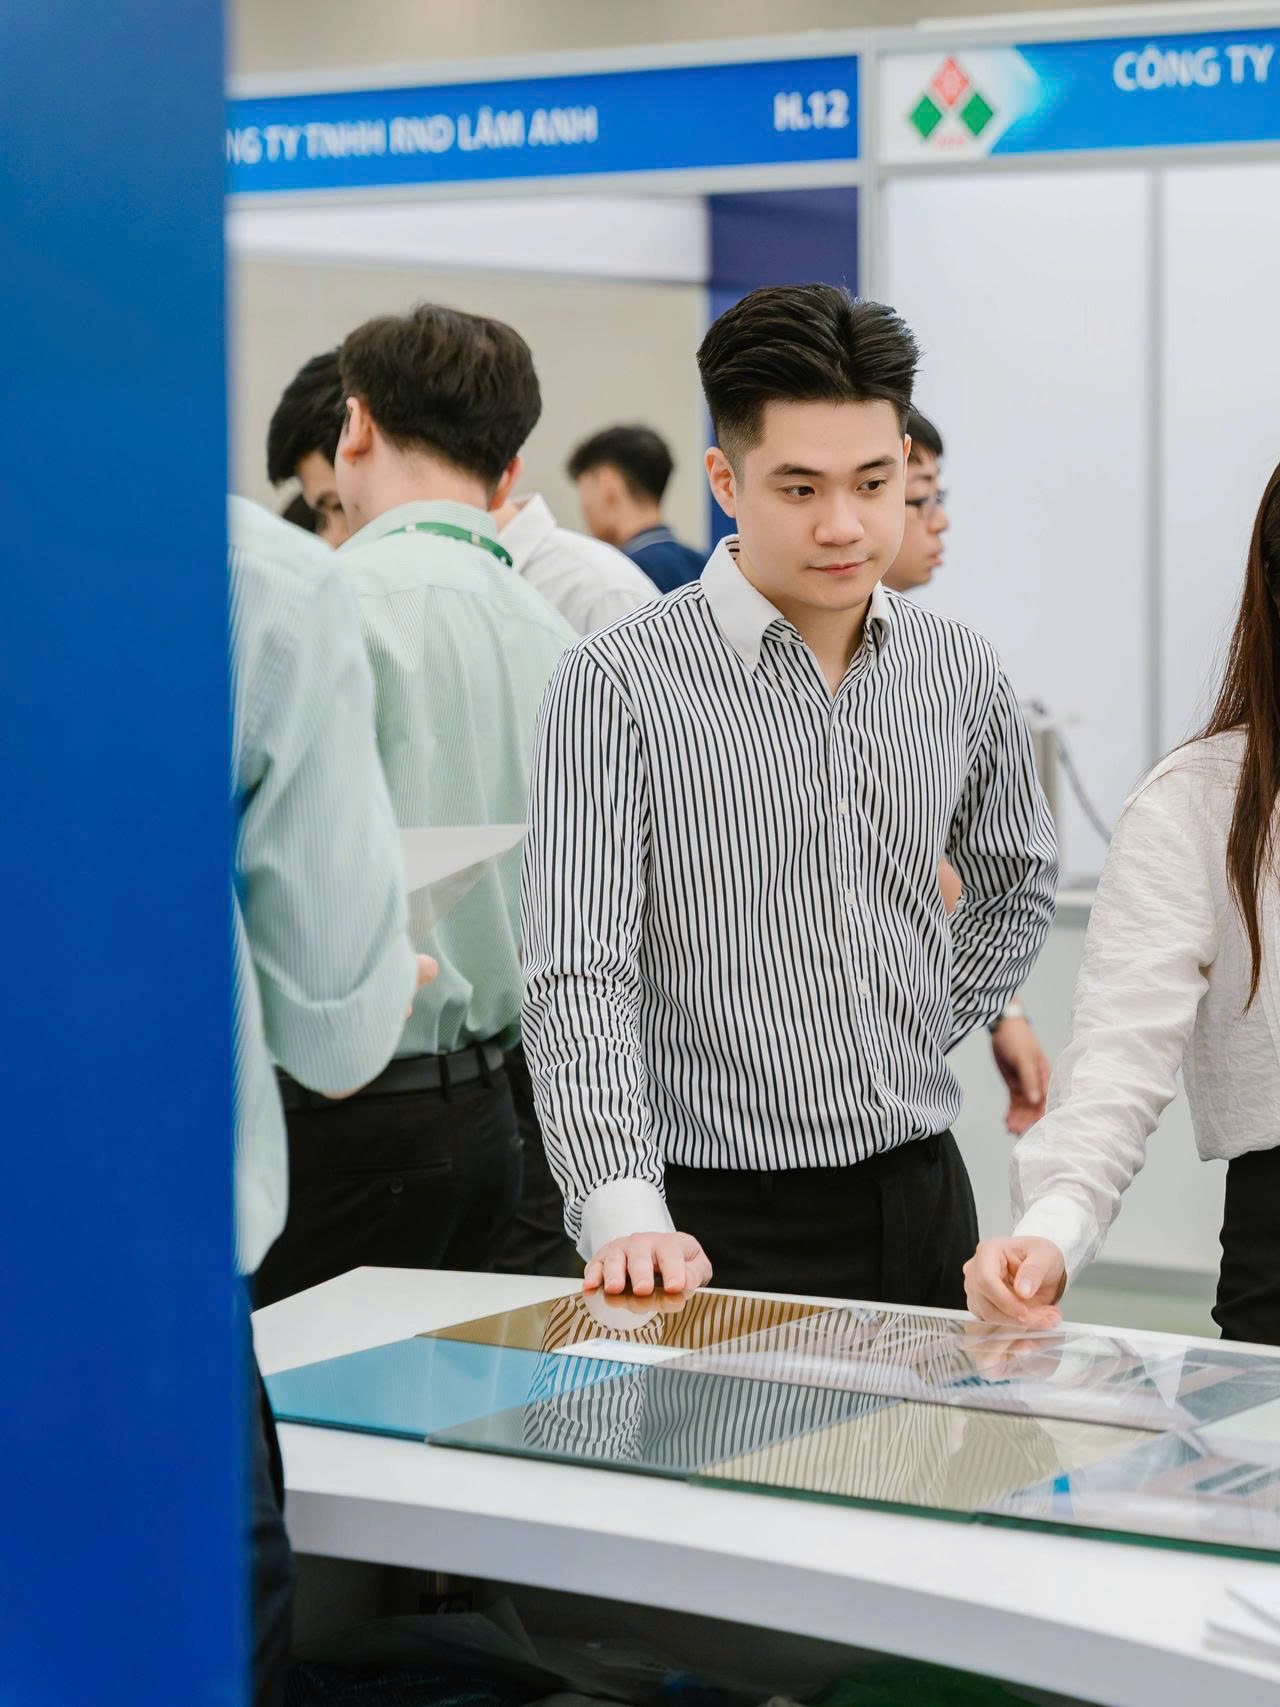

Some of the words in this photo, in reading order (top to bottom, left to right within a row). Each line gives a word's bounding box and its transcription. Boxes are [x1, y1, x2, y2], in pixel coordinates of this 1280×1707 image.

[1112, 44, 1221, 91] CÔNG
[1224, 43, 1276, 84] TY
[264, 123, 302, 163] TY
[527, 105, 599, 147] ANH
[774, 89, 850, 132] H.12
